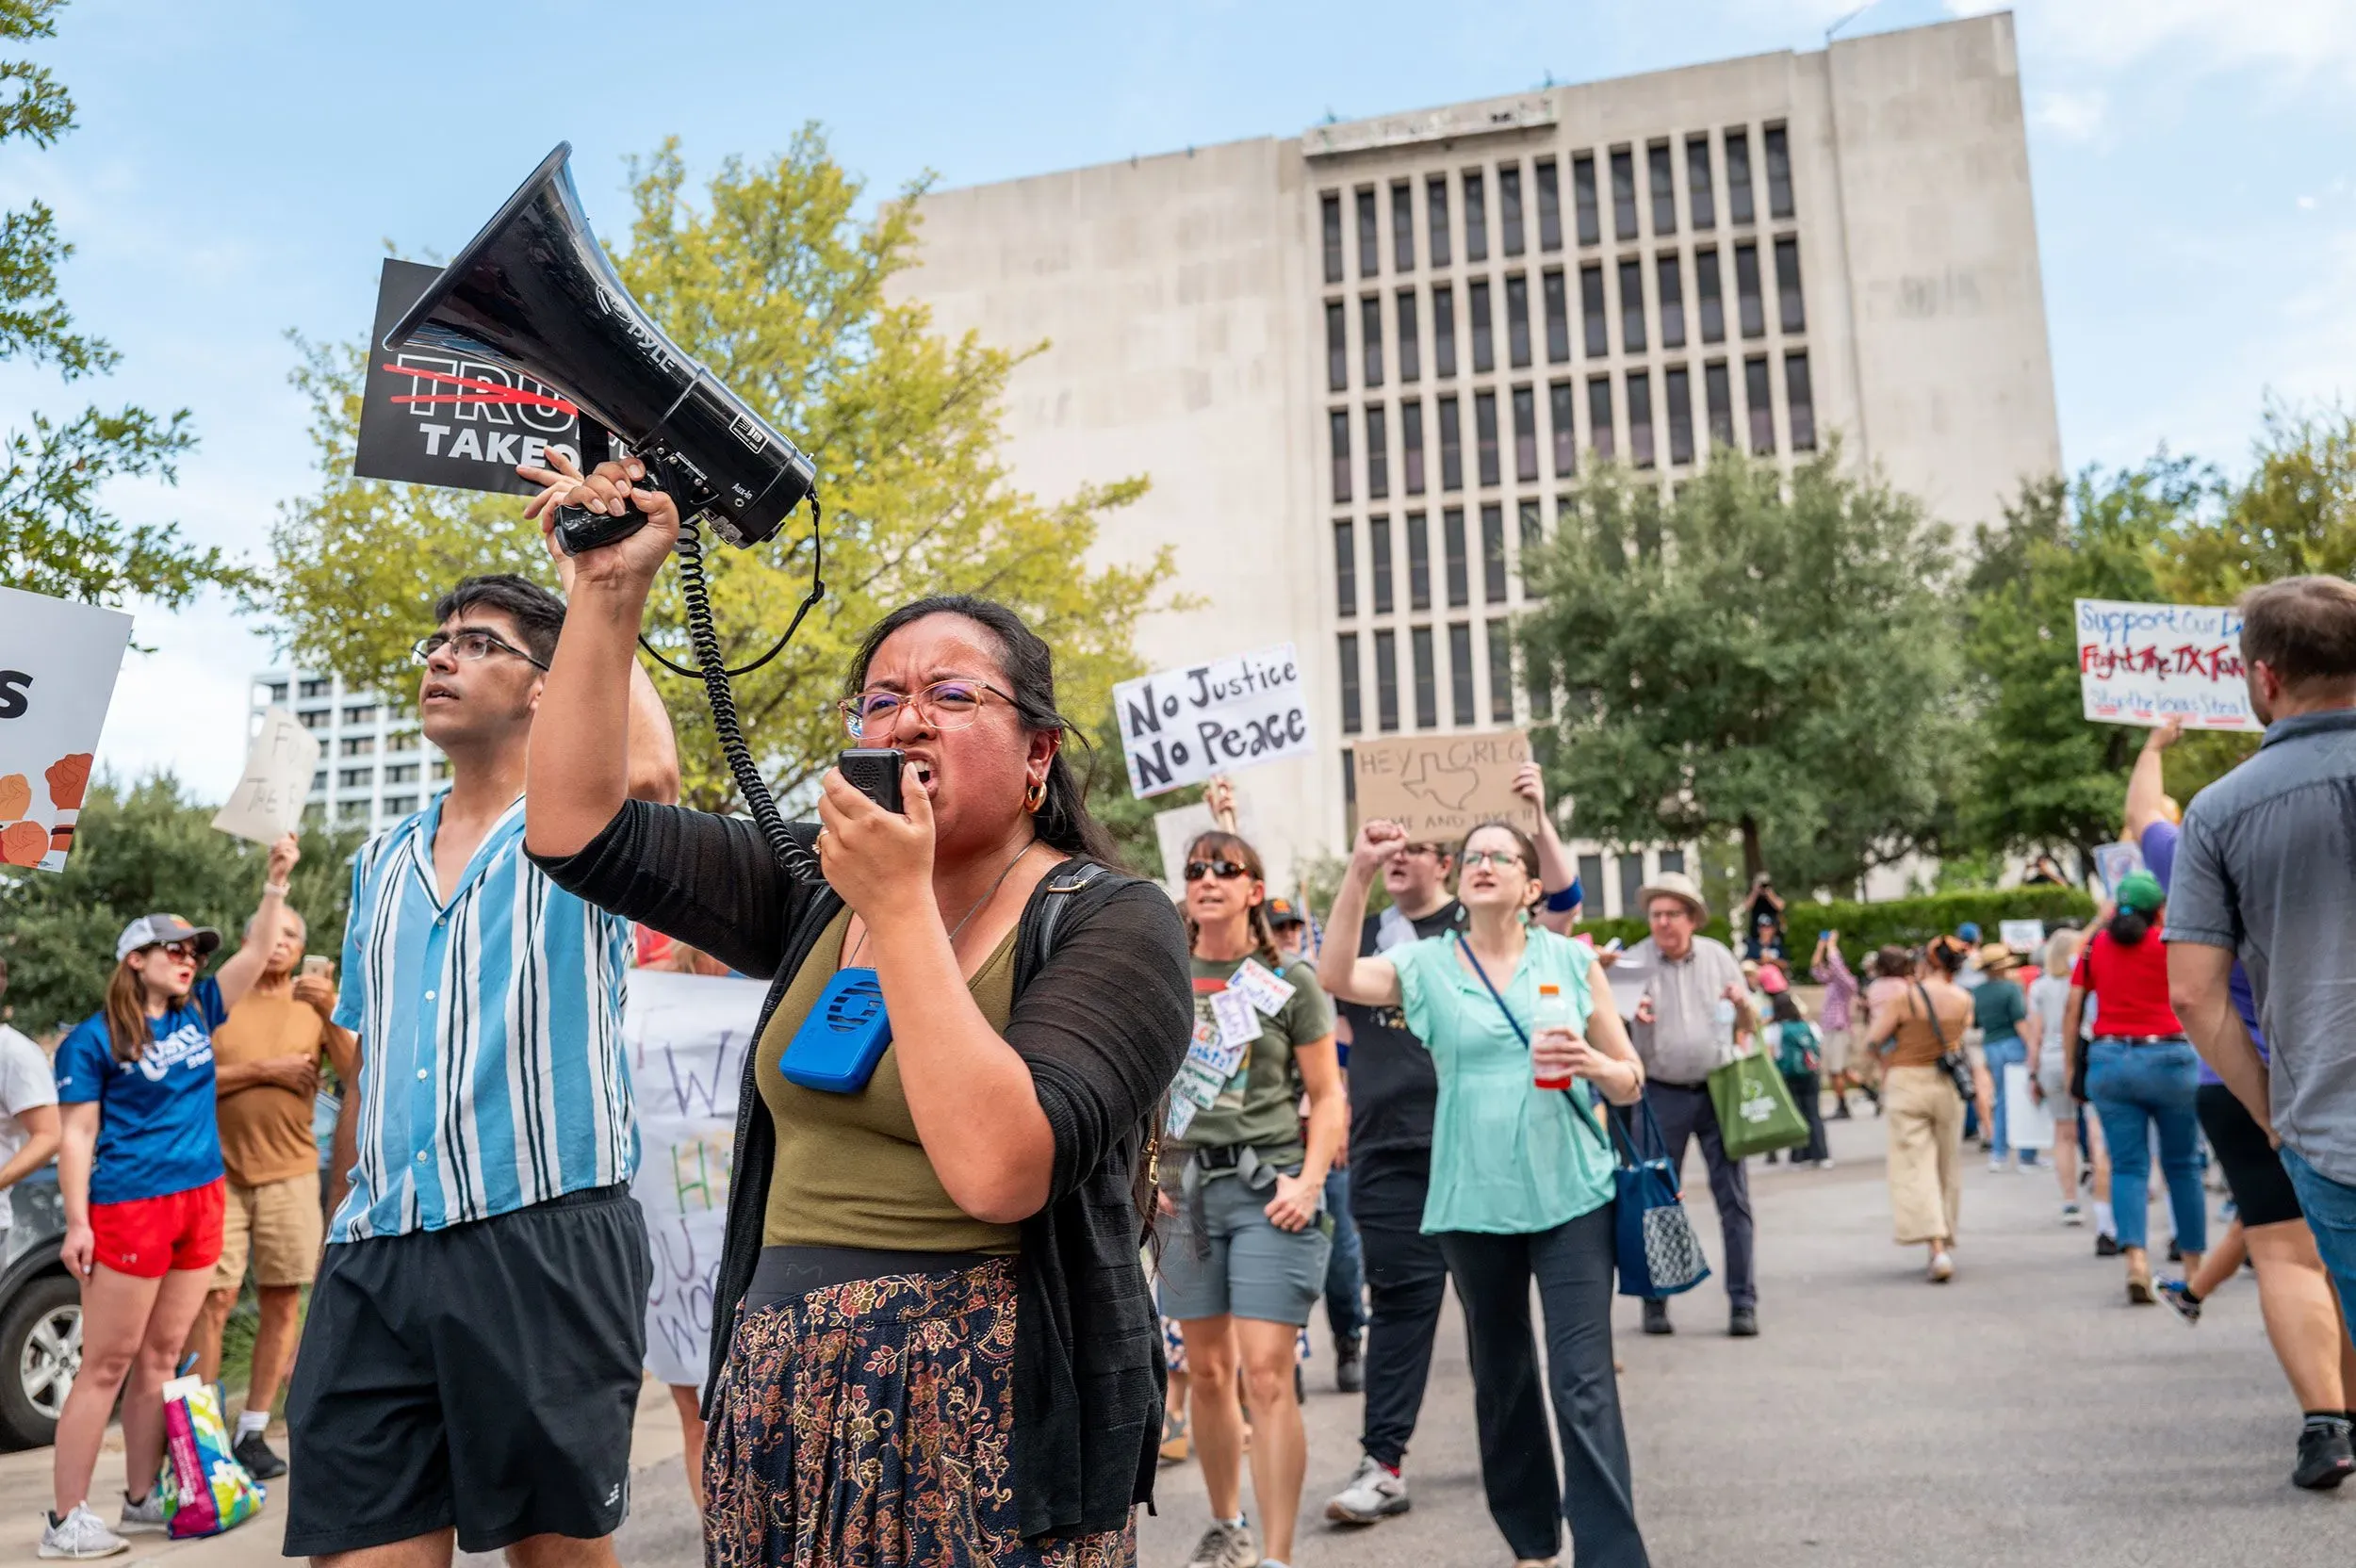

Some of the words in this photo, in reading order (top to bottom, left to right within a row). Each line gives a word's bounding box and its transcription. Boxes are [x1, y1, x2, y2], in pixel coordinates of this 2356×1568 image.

[1128, 680, 1179, 738] No
[1186, 661, 1297, 709] Justice
[1134, 739, 1189, 790] No
[1197, 708, 1306, 765] Peace
[1360, 747, 1412, 778] HEY
[1424, 814, 1465, 830] AND
